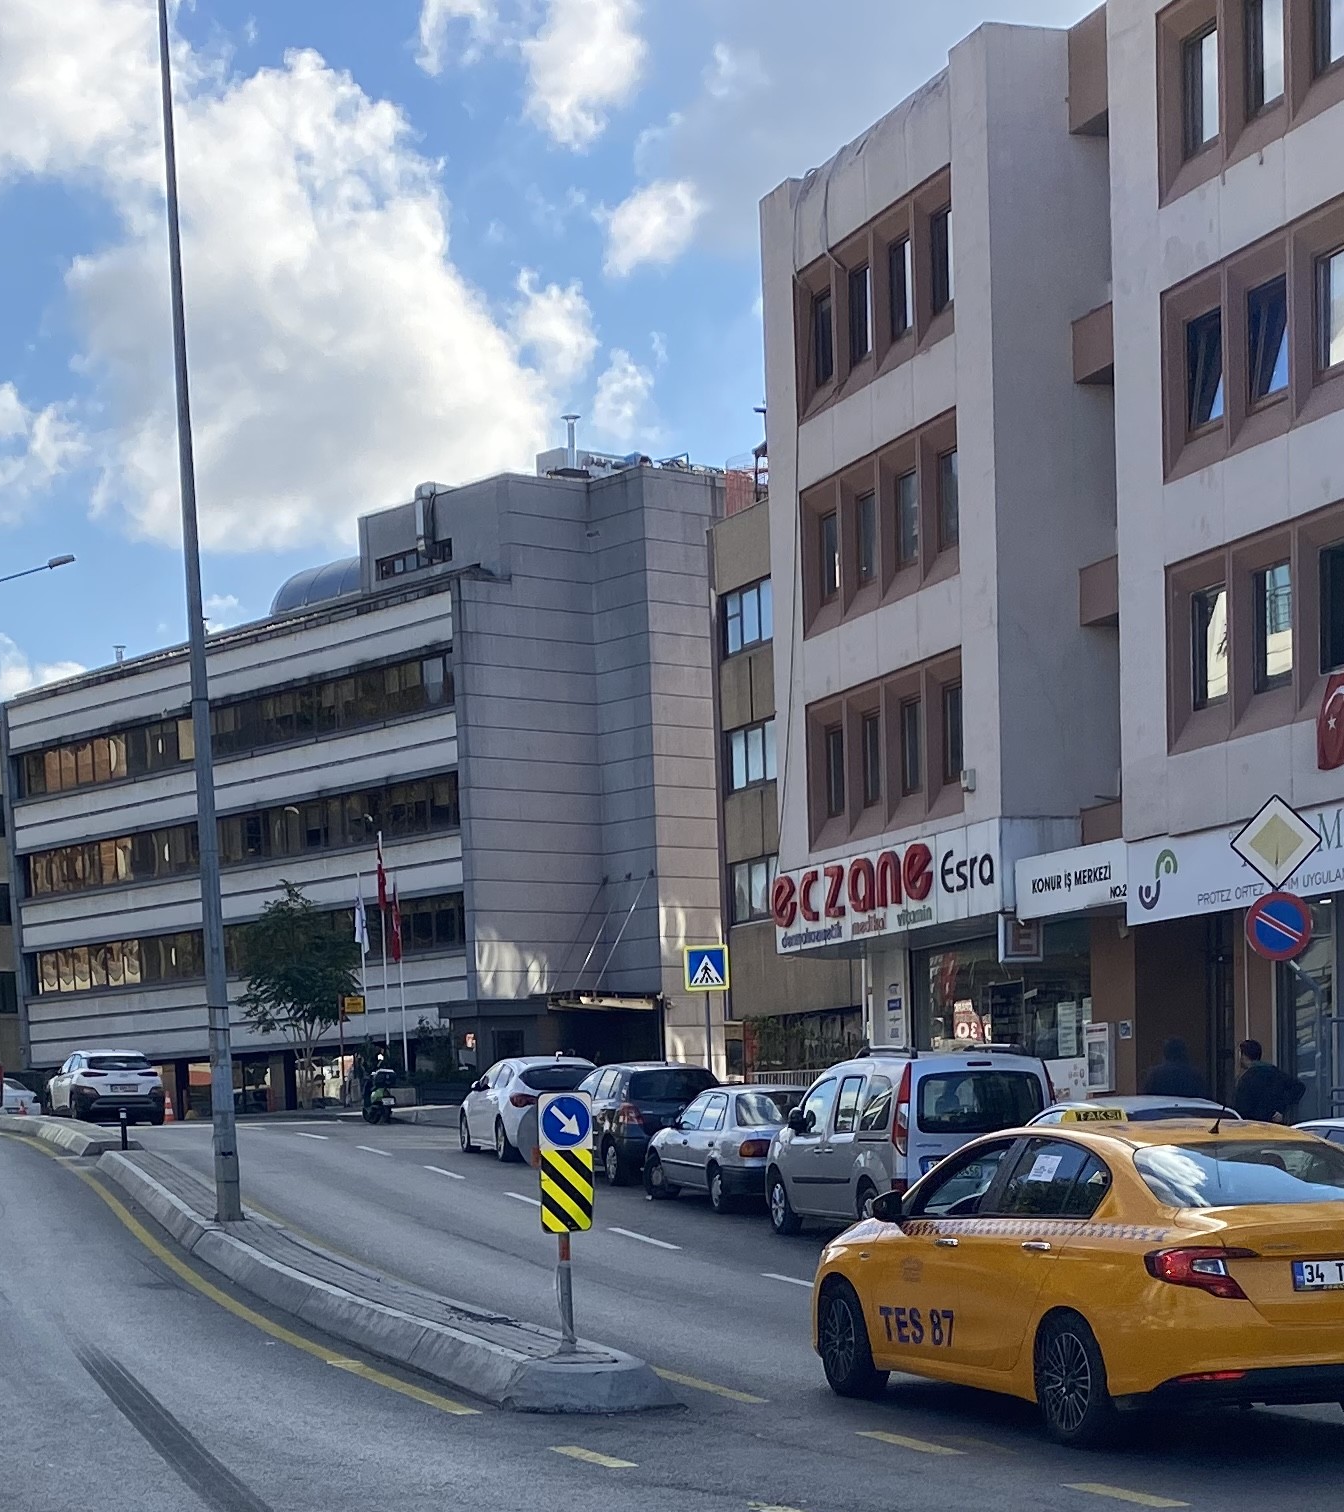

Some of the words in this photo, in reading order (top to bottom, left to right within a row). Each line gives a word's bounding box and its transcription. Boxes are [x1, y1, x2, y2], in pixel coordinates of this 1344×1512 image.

[772, 843, 934, 928] eczane
[940, 849, 995, 893] Esra
[1031, 874, 1062, 894] KONUR
[1064, 869, 1072, 892] İŞ
[1074, 861, 1112, 886] MERKEZİ
[1197, 888, 1232, 905] PROTEZ
[1234, 882, 1265, 900] ORTEZ
[897, 904, 932, 926] vitamin
[1305, 1262, 1325, 1283] 34
[879, 1305, 924, 1344] TES
[929, 1308, 954, 1347] 87
